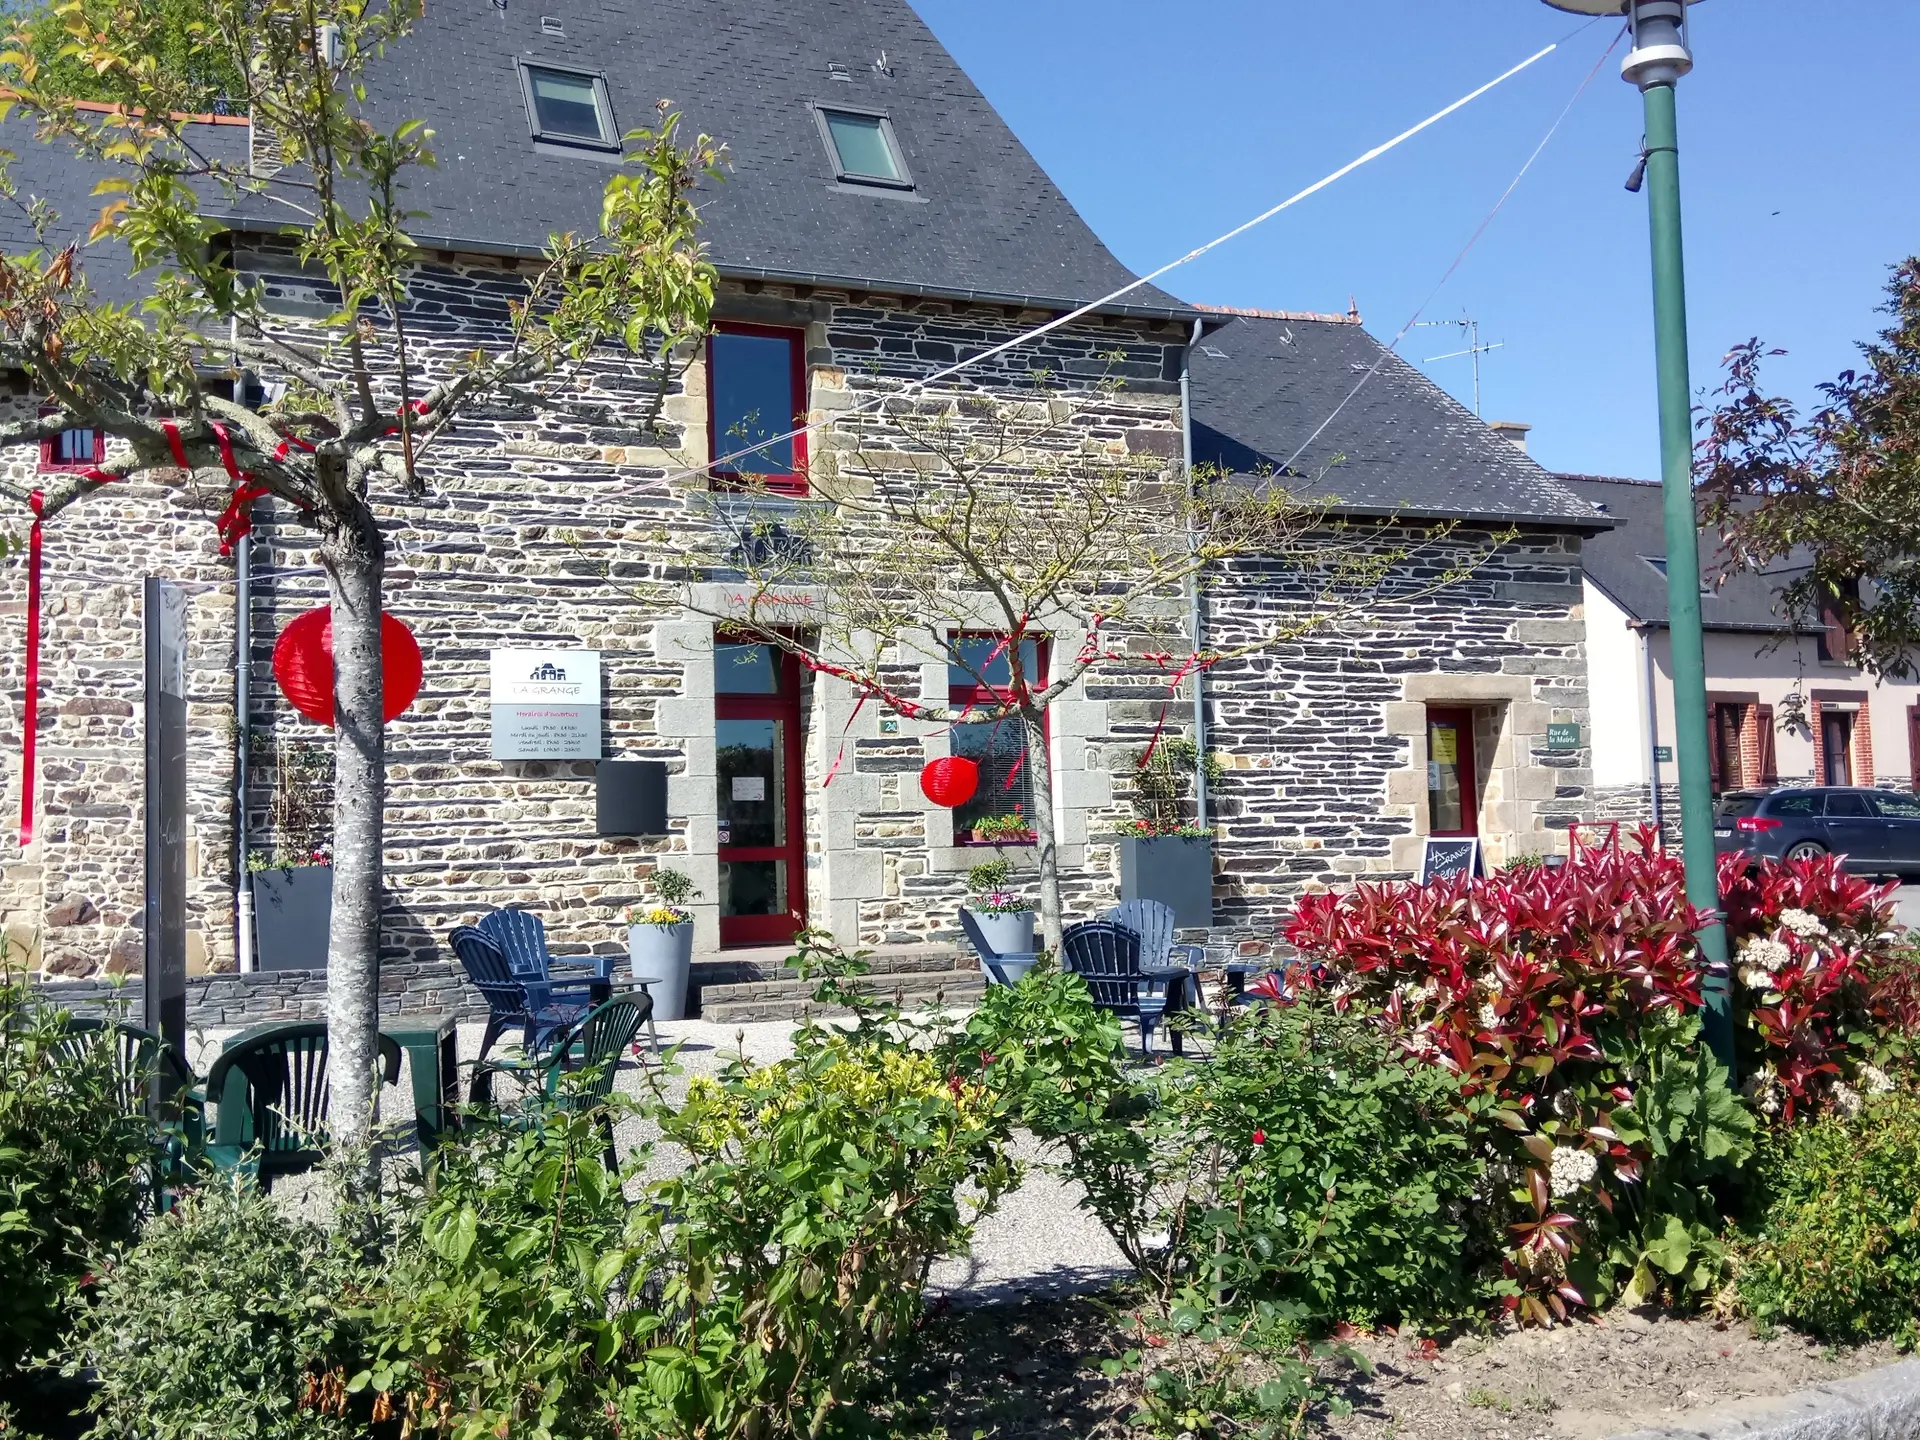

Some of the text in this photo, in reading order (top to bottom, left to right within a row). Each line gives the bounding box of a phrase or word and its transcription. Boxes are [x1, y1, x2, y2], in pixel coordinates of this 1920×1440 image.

[532, 686, 580, 696] GRANGE
[1549, 728, 1569, 736] Rue de
[1556, 736, 1576, 744] Mairie
